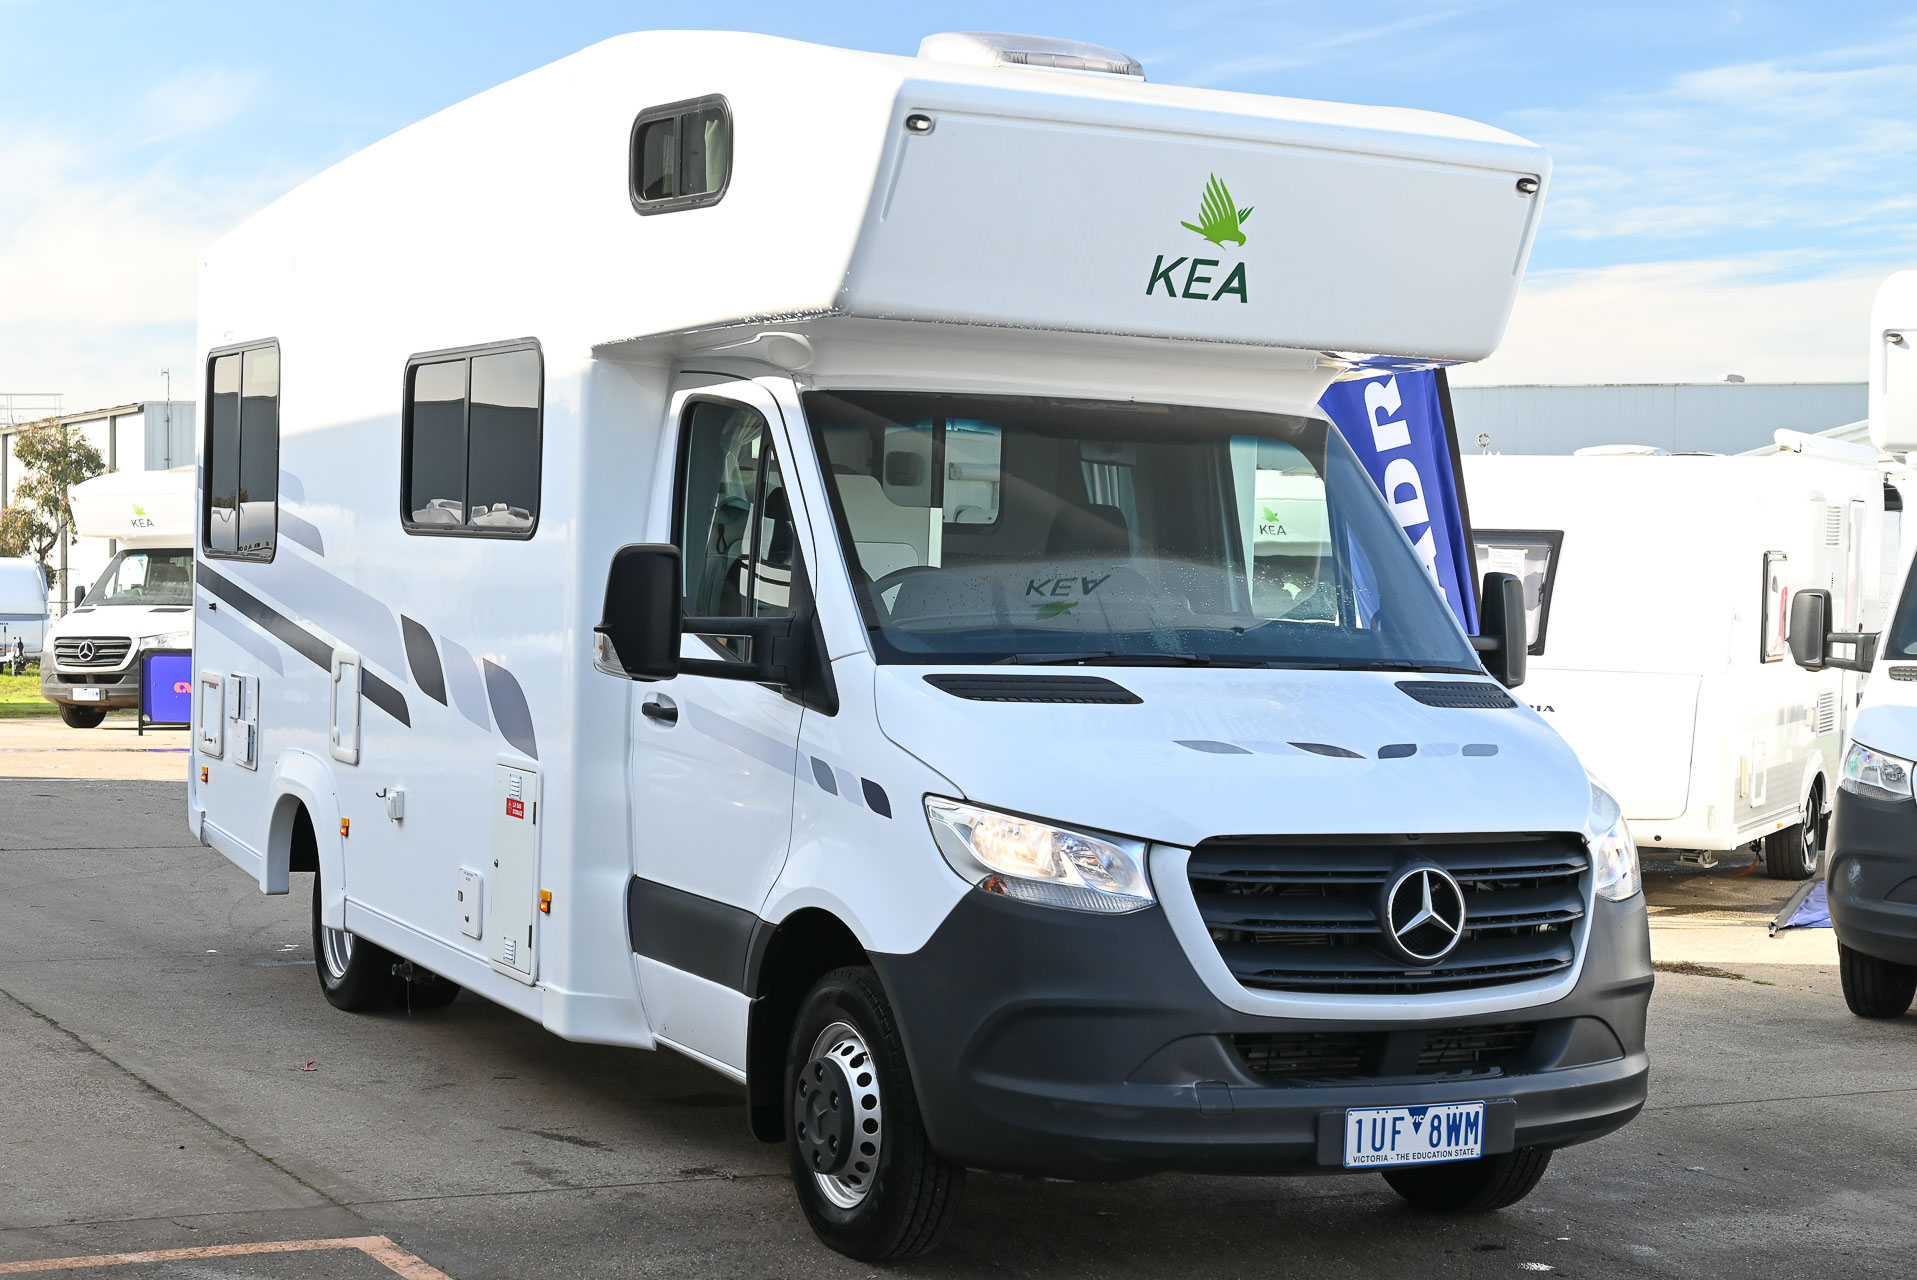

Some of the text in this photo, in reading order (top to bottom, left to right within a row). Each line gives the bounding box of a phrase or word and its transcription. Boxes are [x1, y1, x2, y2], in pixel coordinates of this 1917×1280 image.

[1146, 255, 1248, 303] KEA
[130, 518, 155, 528] KEA
[1260, 524, 1287, 536] KEA
[1356, 1110, 1480, 1153] 1UF 8WM
[1353, 1154, 1389, 1163] VICTORIA
[1396, 1153, 1410, 1161] THE
[1412, 1150, 1453, 1160] EDUCATION
[1454, 1148, 1475, 1157] STATE
